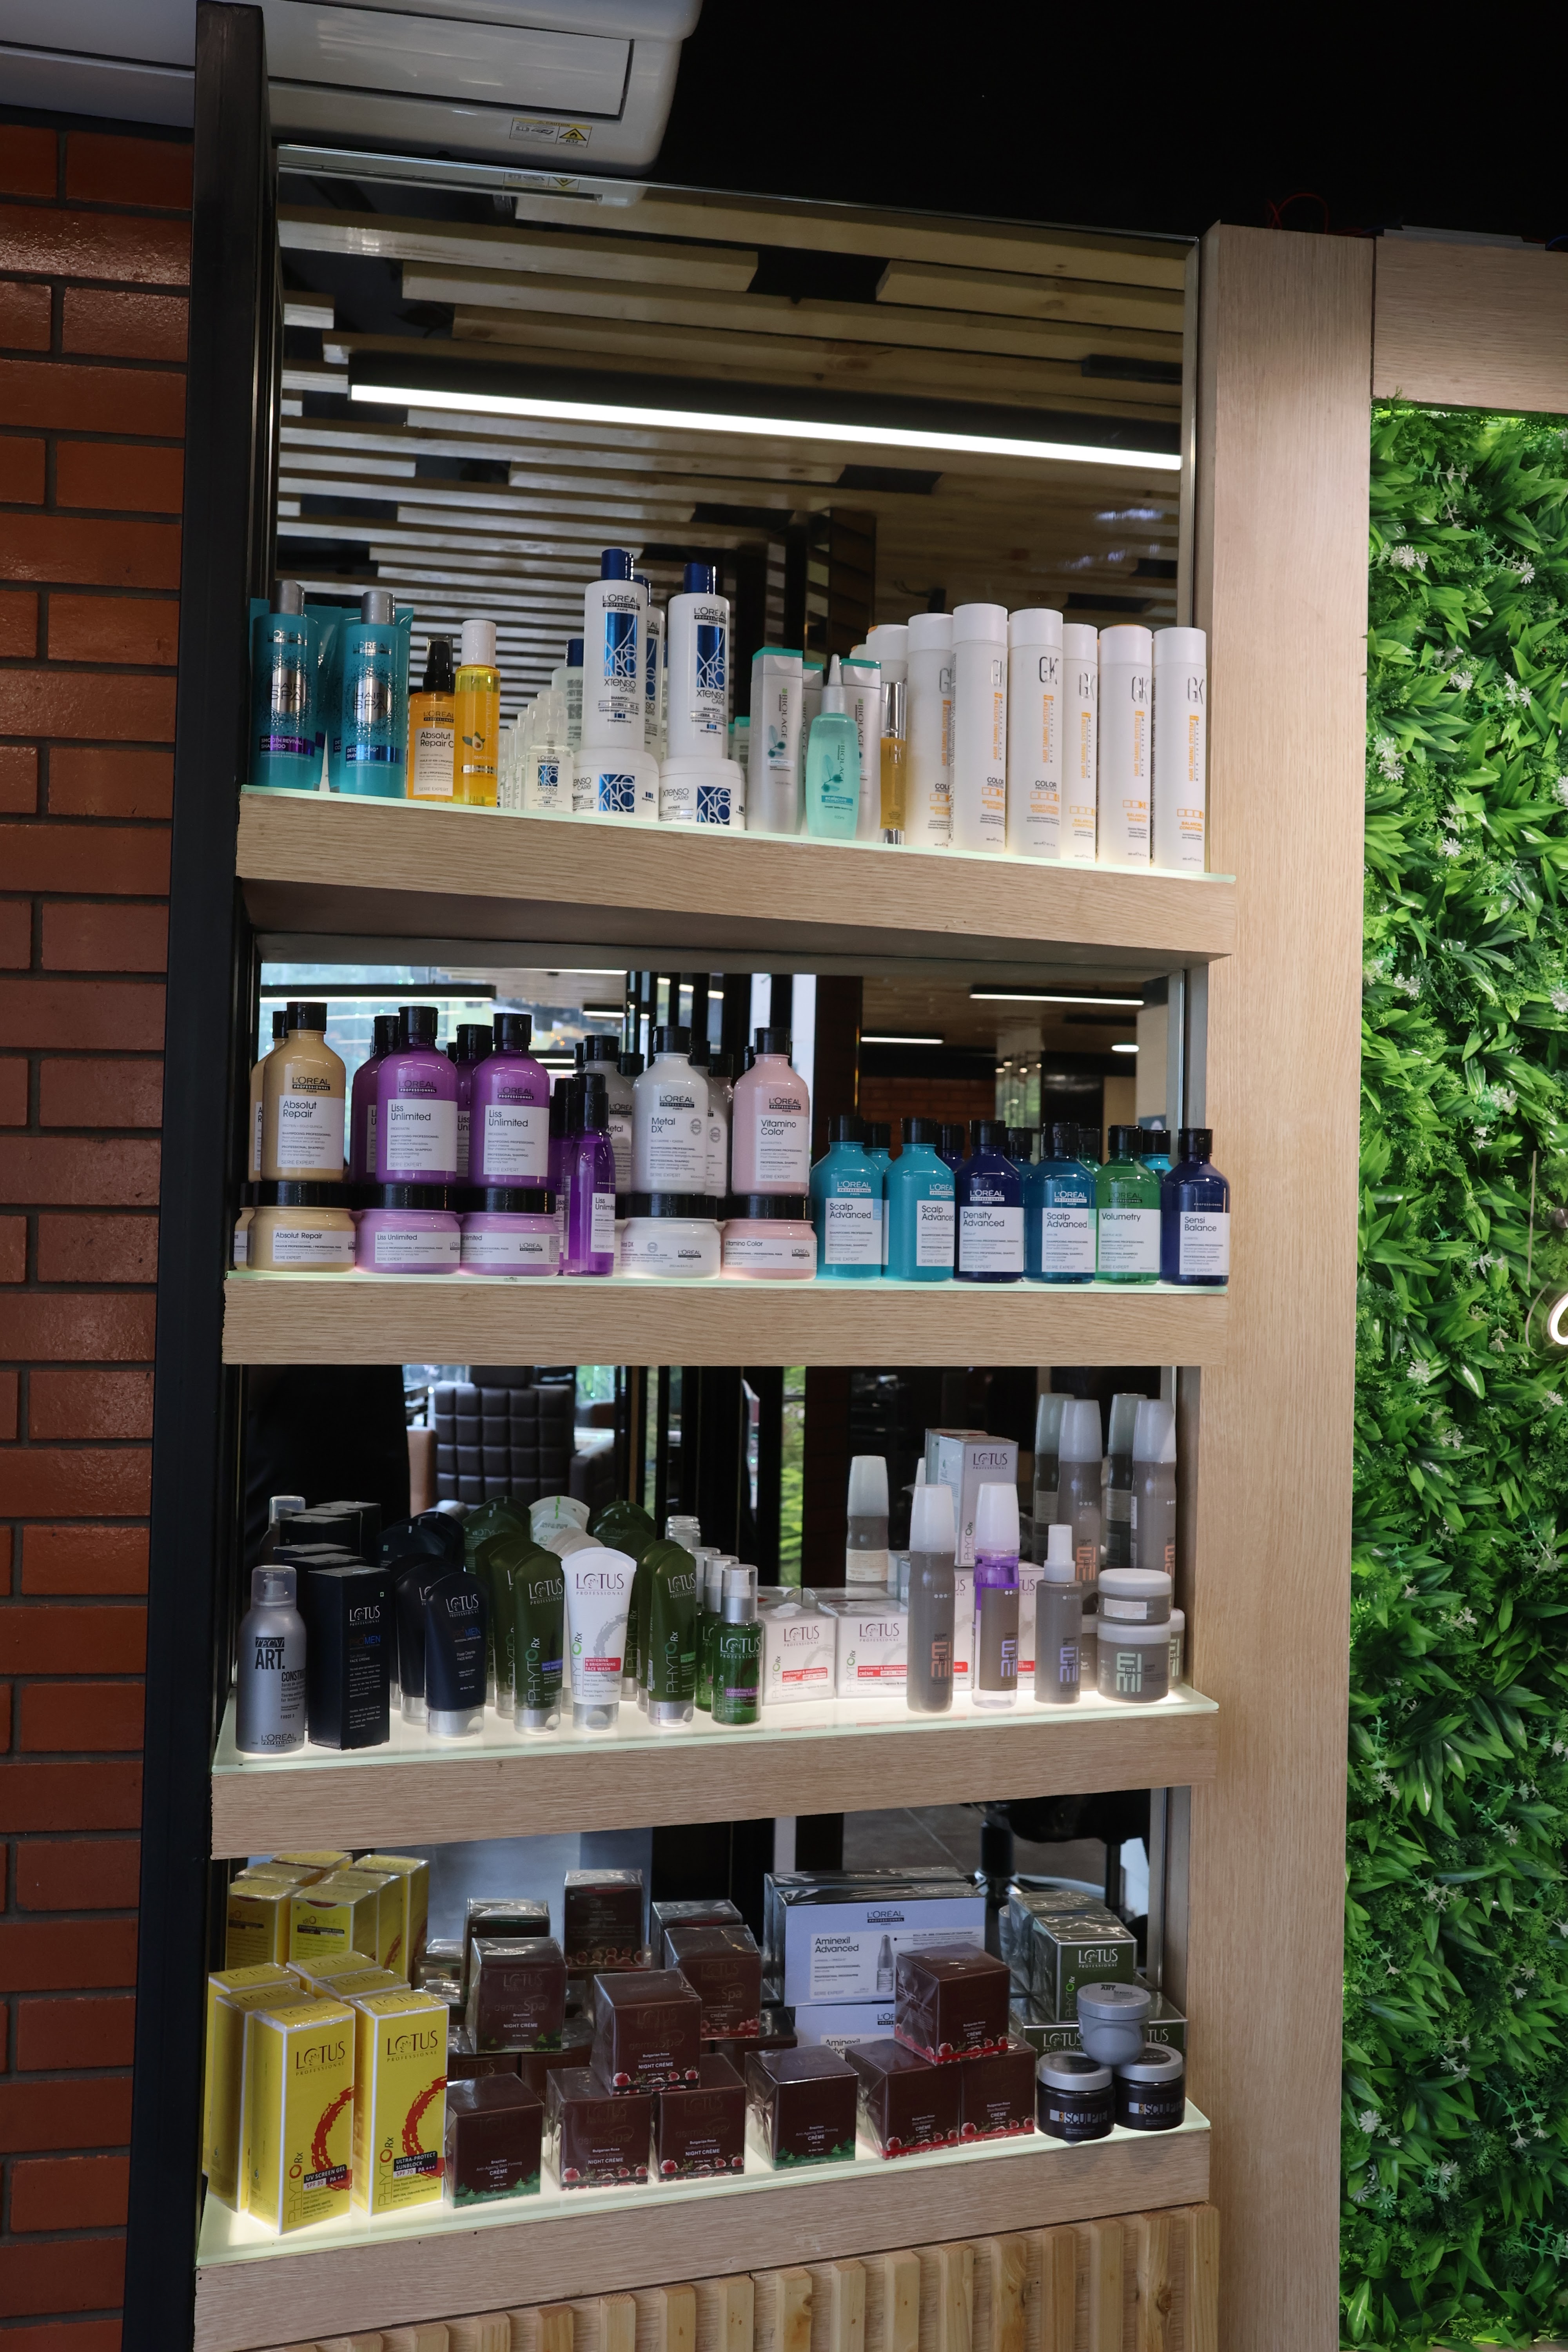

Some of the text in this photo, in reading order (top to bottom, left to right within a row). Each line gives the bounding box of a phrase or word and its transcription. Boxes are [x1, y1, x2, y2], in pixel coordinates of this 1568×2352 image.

[603, 593, 640, 605] L'ORÉAL
[694, 607, 726, 619] L'ORÉAL
[1039, 656, 1058, 685] GK
[1079, 672, 1096, 701] GK
[1132, 676, 1150, 704] GK
[1188, 678, 1205, 704] GK
[353, 700, 387, 711] SPA
[420, 731, 450, 740] Absolut
[420, 739, 446, 748] Repair
[292, 1077, 330, 1085] L'ORÉAL
[497, 1087, 534, 1095] L'ORÉAL
[283, 1100, 317, 1109] Absolut
[283, 1109, 313, 1119] Repair
[489, 1118, 528, 1127] Unlimited
[761, 1120, 796, 1128] Vitamino
[829, 1203, 853, 1211] Scalp
[922, 1205, 943, 1214] Scalp
[963, 1211, 992, 1220] Density
[1047, 1212, 1070, 1221] Scalp
[1102, 1213, 1141, 1222] Volumetry
[973, 1453, 1007, 1466] LOTUS
[576, 1573, 624, 1589] LOTUS
[668, 1573, 695, 1593] LOTUS
[529, 1578, 563, 1599] LOTUS
[446, 1594, 479, 1613] LOTUS
[350, 1606, 380, 1622] LOTUS
[784, 1626, 819, 1642] LOTUS
[860, 1623, 899, 1637] LOTUS
[256, 1639, 284, 1647] TECNI
[720, 1637, 760, 1653] LOTUS
[255, 1649, 285, 1670] ART.
[867, 1910, 904, 1919] L'ORÉAL
[815, 1937, 850, 1945] Aminexil
[815, 1944, 859, 1953] Advanced
[1079, 1949, 1118, 1964] LOTUS
[387, 2030, 438, 2055] LOTUS
[296, 2040, 345, 2069] LOTUS
[387, 2050, 437, 2062] PROFESSIONAL
[296, 2062, 344, 2076] PROFESSIONAL
[396, 2152, 436, 2164] ULTRA-PROTECT
[396, 2160, 422, 2170] SUNBLOCK
[315, 2169, 335, 2179] SCREEN
